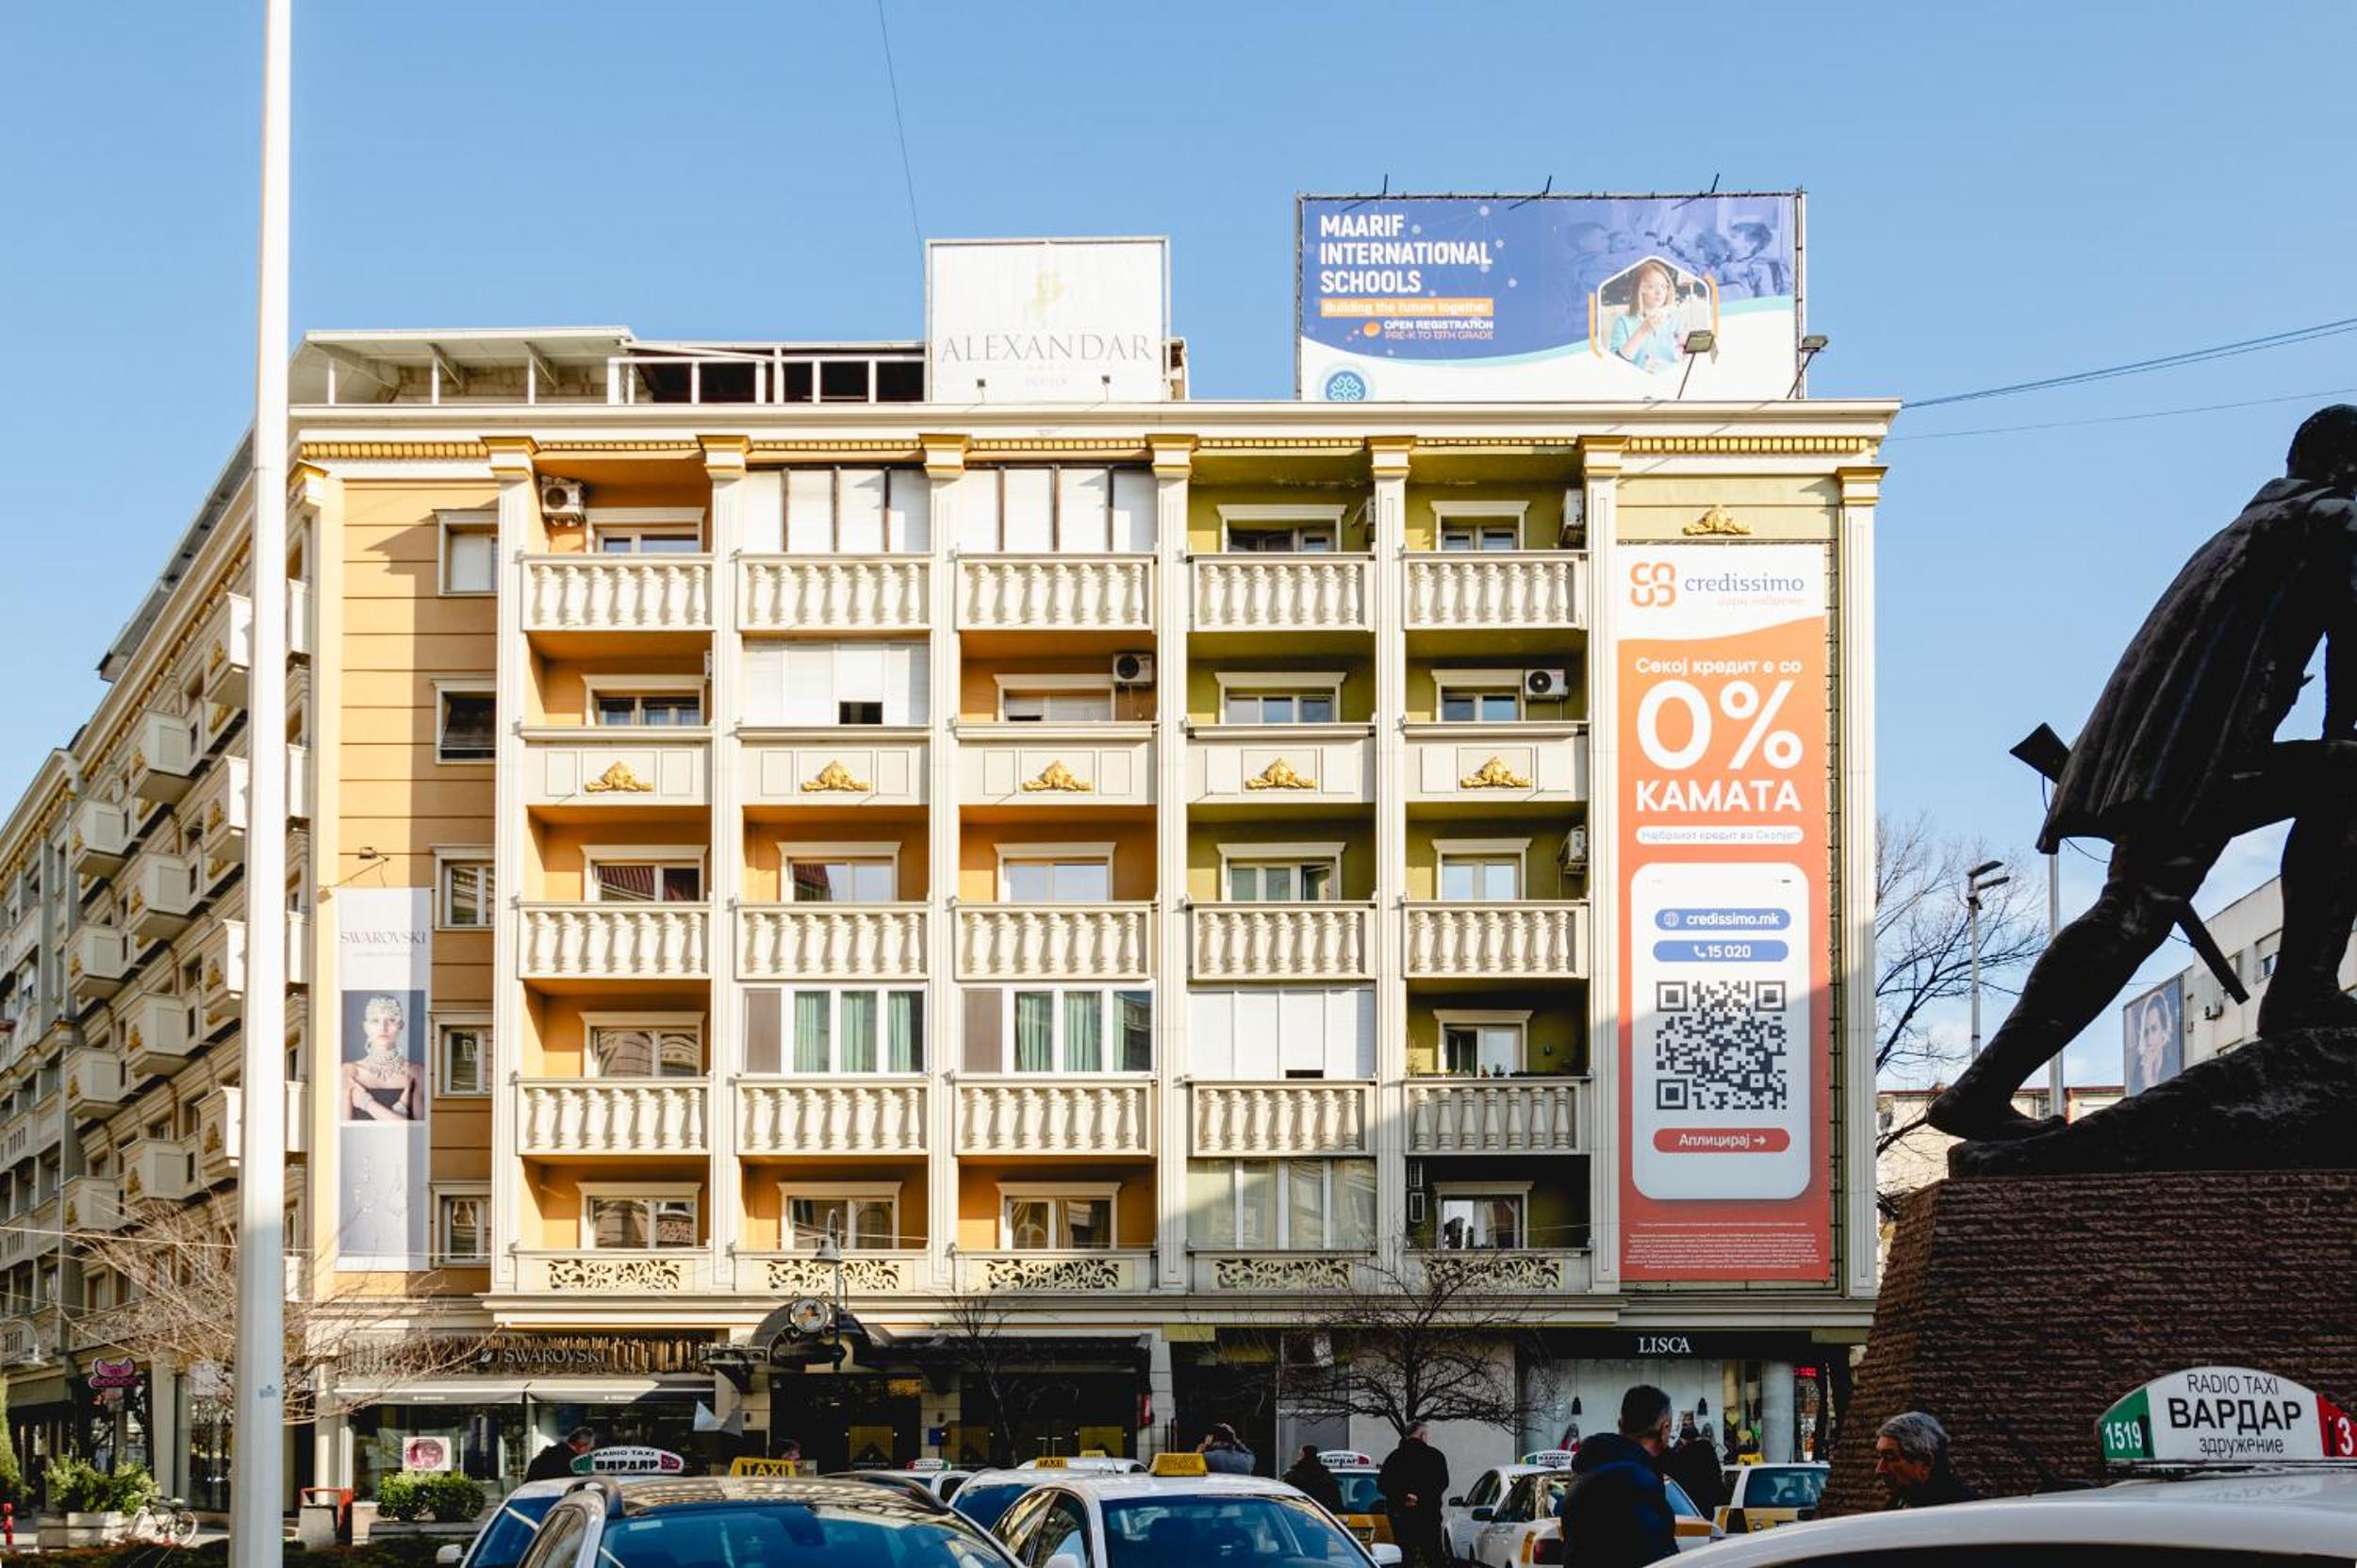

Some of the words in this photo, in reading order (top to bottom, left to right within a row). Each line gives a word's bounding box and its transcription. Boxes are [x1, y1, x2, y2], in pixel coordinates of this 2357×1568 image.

[1320, 214, 1405, 238] MAARIF
[1320, 242, 1493, 265] INTERNATIONAL
[1320, 270, 1422, 293] SCHOOLS
[1324, 301, 1374, 316] Building
[1376, 301, 1396, 313] the
[1383, 320, 1413, 330] OPEN
[1415, 320, 1493, 330] REGISTRATION
[941, 333, 1154, 362] ALEXANDAR
[1685, 572, 1805, 592] credissimo
[1635, 657, 1689, 676] Секој
[1692, 660, 1759, 677] кредит
[1763, 660, 1774, 673] е
[1779, 660, 1803, 673] со
[1637, 679, 1804, 770] 0%
[1636, 780, 1803, 813] КАМАТА
[1686, 912, 1781, 926] credissimo.mk
[339, 931, 426, 944] SWAROVSKI
[1706, 945, 1722, 958] 15
[1724, 945, 1752, 958] 020
[1678, 1133, 1751, 1148] Аплицирај
[503, 1347, 606, 1363] SWAROVSKI
[1638, 1336, 1692, 1354] LISCA
[2186, 1374, 2240, 1395] RADIO
[2243, 1376, 2280, 1395] TAXI
[2167, 1397, 2302, 1436] ВАРДАР
[2104, 1420, 2143, 1451] 1519
[2199, 1436, 2284, 1459] здружение
[594, 1460, 660, 1471] ВАРДАР
[741, 1462, 790, 1477] TAXI
